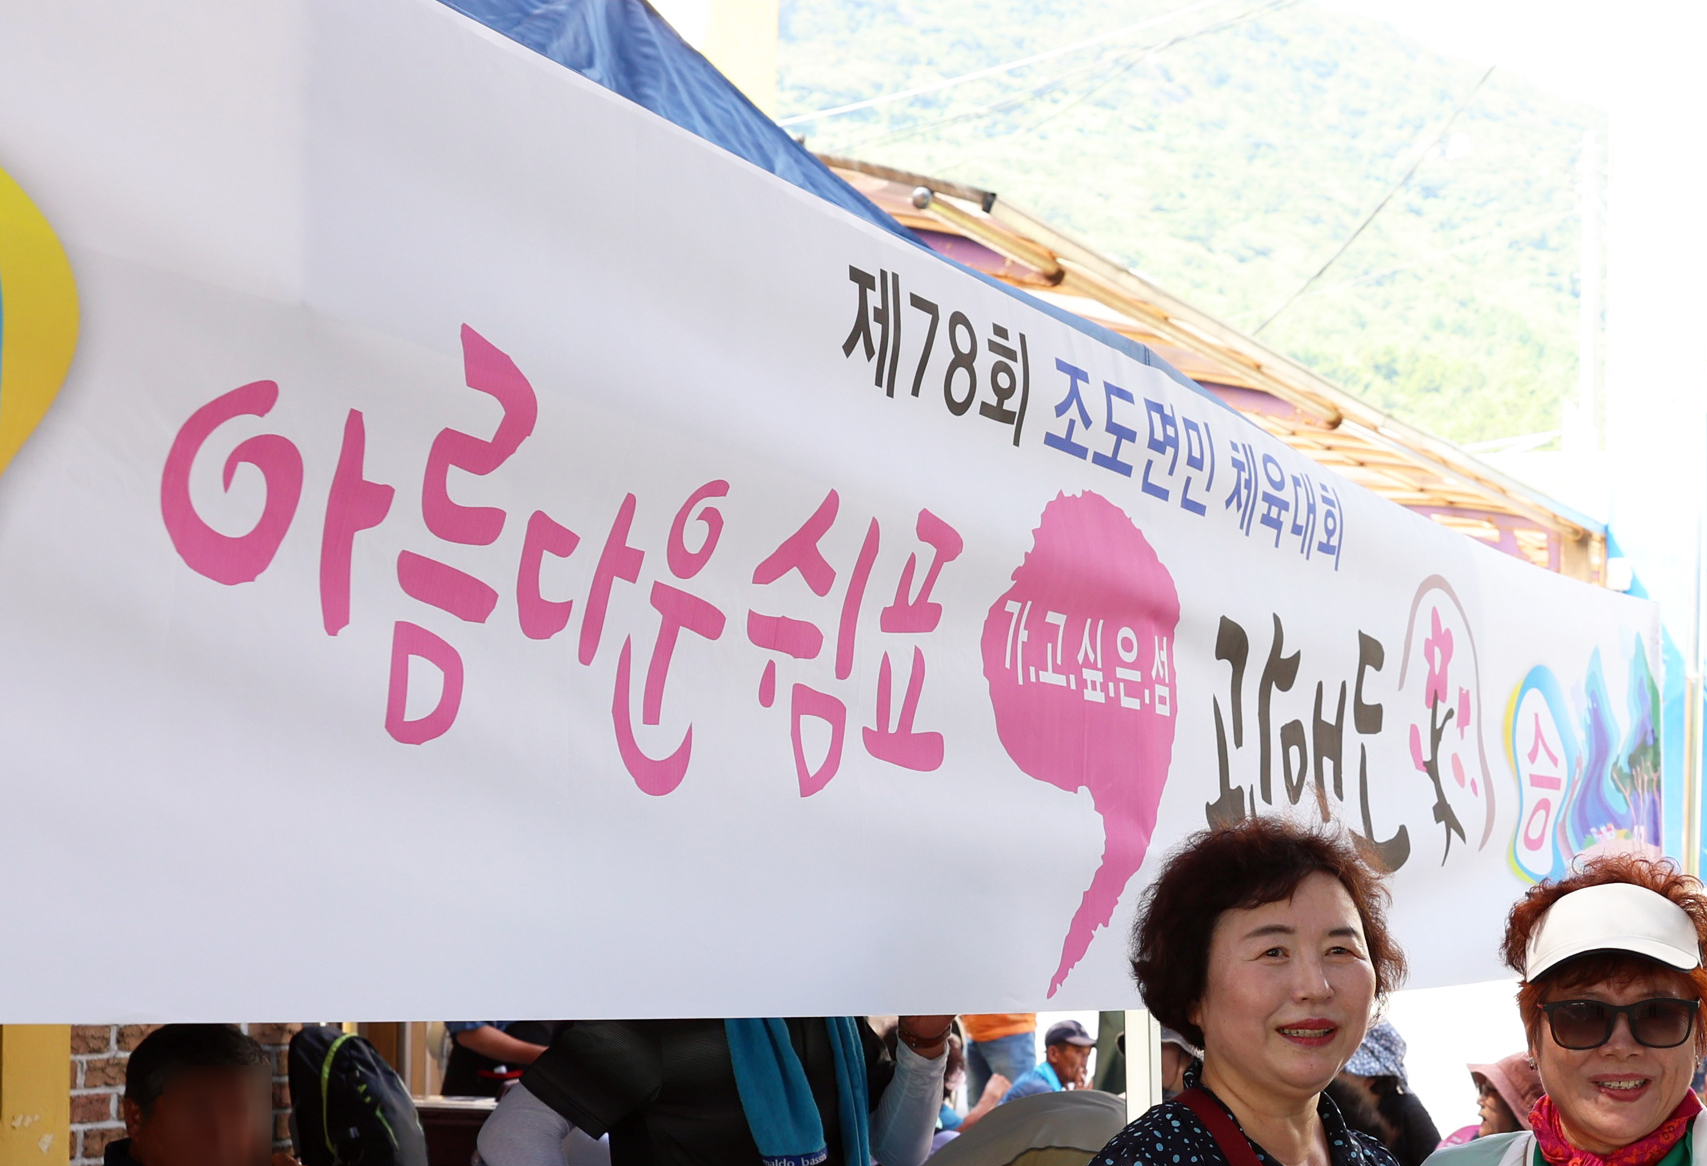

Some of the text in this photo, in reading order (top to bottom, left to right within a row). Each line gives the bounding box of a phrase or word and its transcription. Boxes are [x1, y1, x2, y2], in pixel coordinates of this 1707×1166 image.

[160, 323, 964, 799] 아름다운 쉼표
[842, 264, 1345, 572] 제78회 조도면민 체육대회
